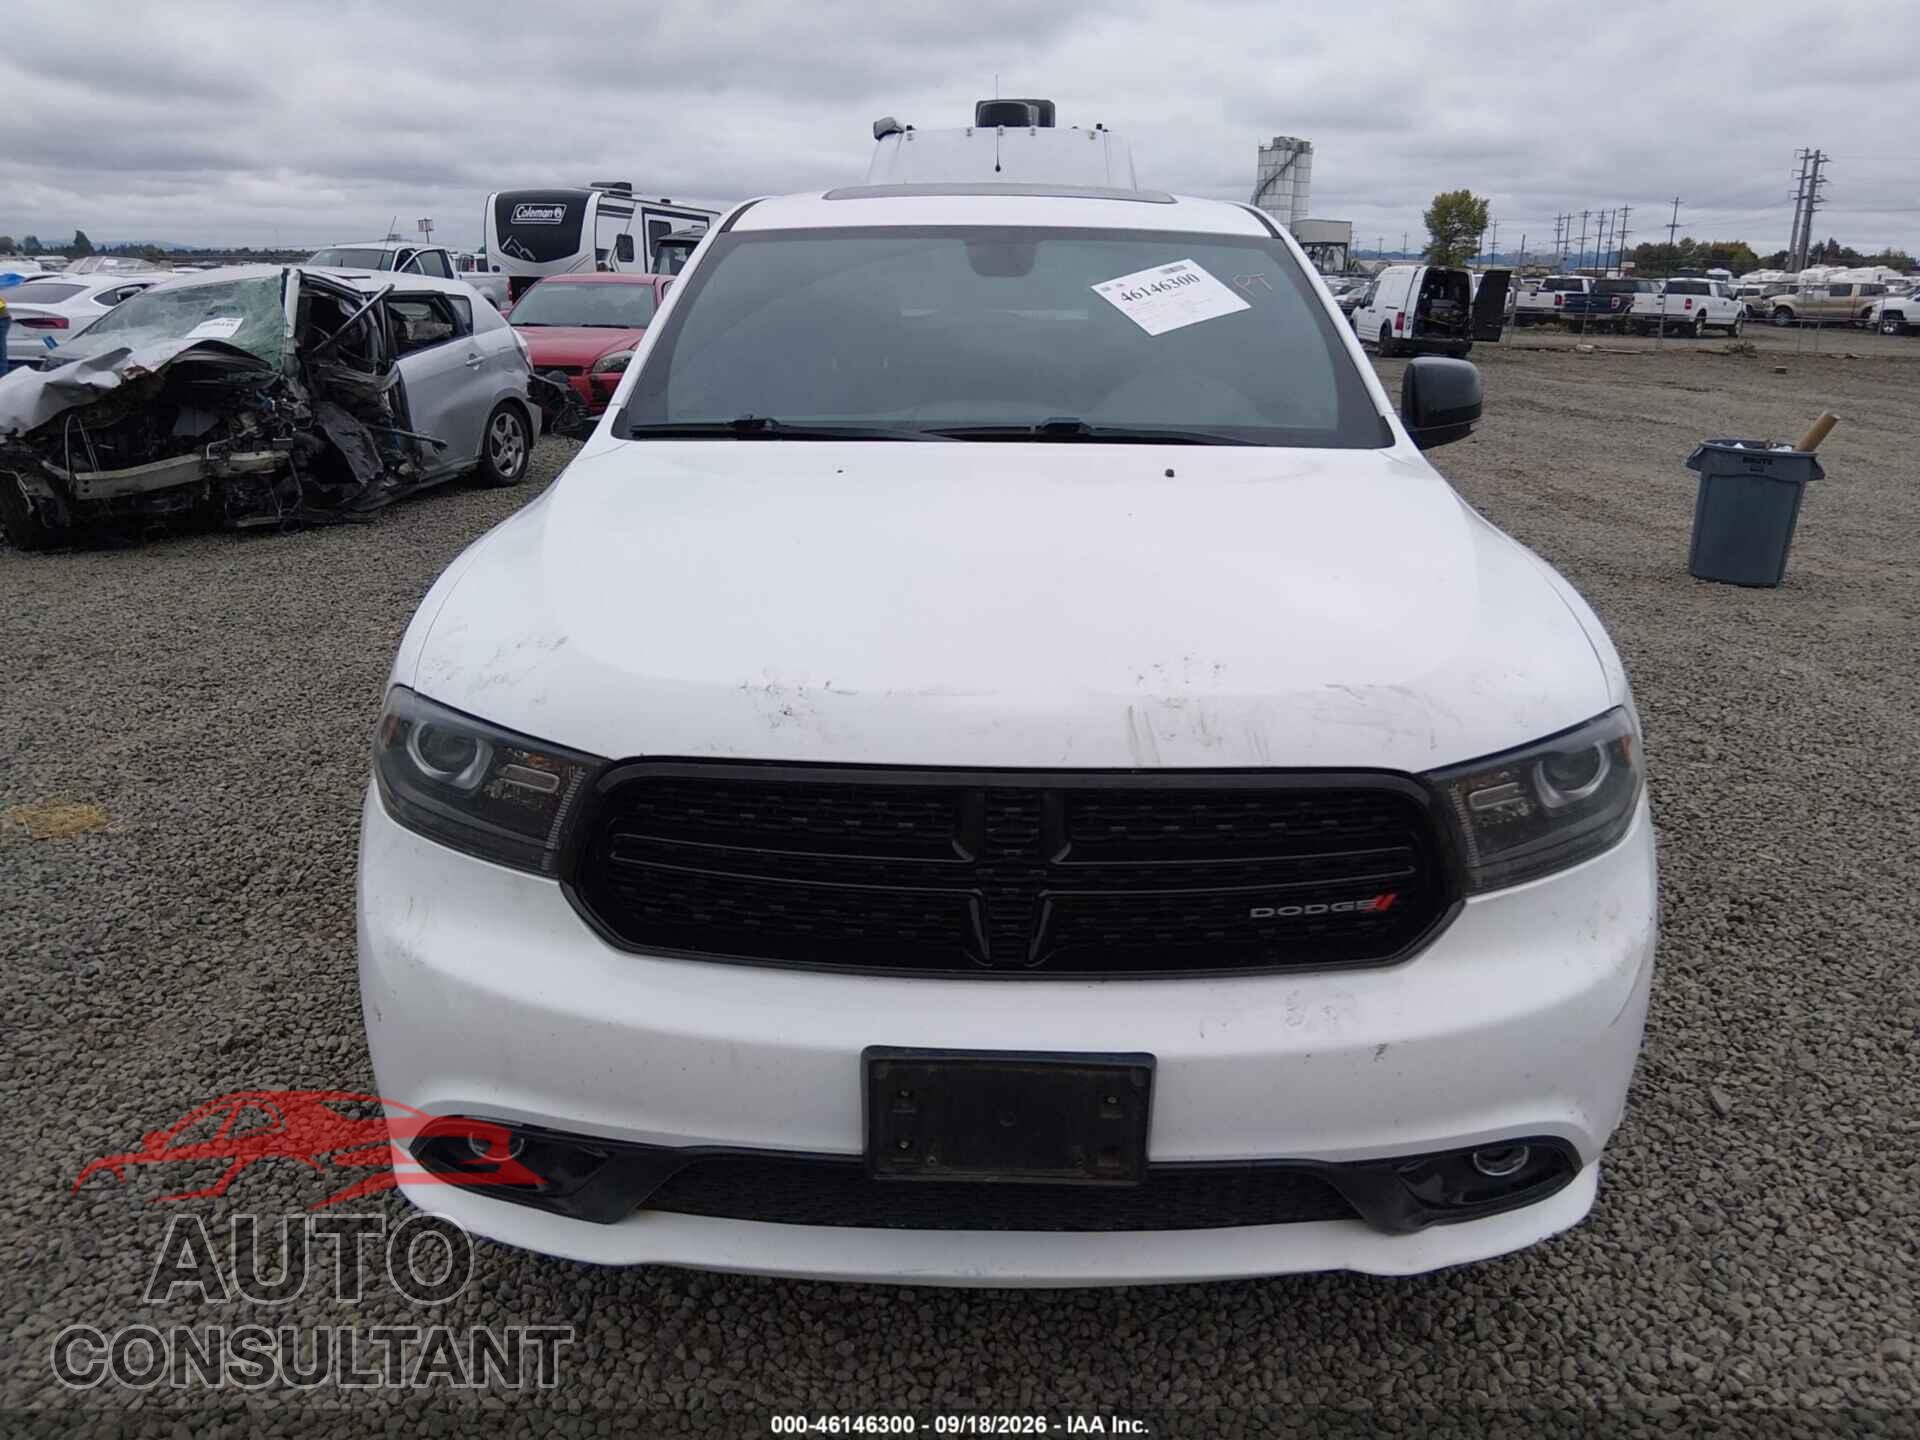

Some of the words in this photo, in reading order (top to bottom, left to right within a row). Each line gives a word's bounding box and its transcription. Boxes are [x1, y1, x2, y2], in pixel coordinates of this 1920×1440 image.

[516, 206, 554, 218] Coleman
[1120, 272, 1201, 302] 46146300
[1250, 899, 1378, 918] DODGE
